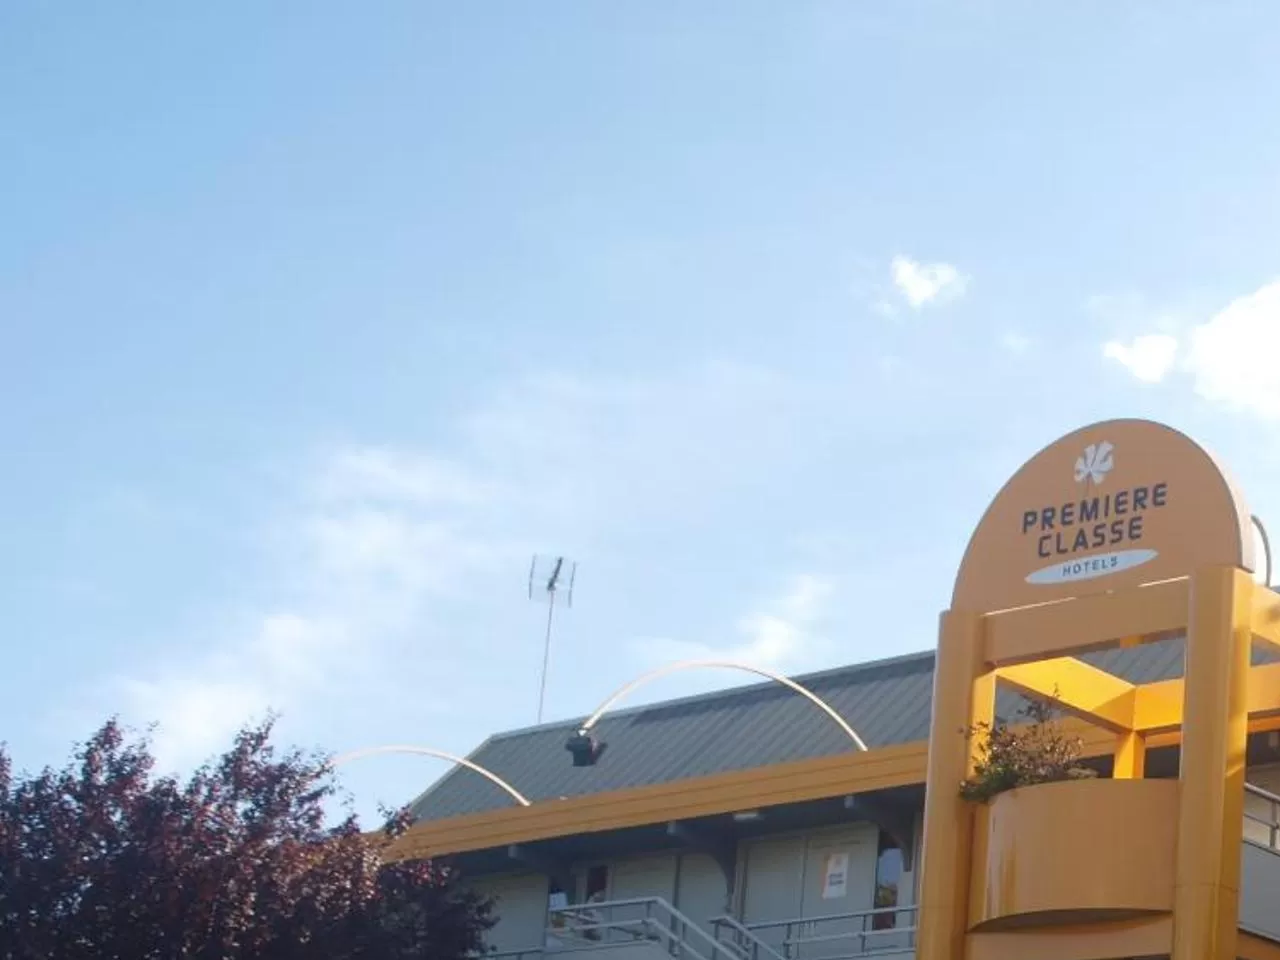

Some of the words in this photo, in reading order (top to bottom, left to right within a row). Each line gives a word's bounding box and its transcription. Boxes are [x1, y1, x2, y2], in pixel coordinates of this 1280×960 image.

[1022, 483, 1168, 534] PREMIERE
[1038, 516, 1143, 558] CLASSE
[1061, 556, 1119, 577] HOTELS
